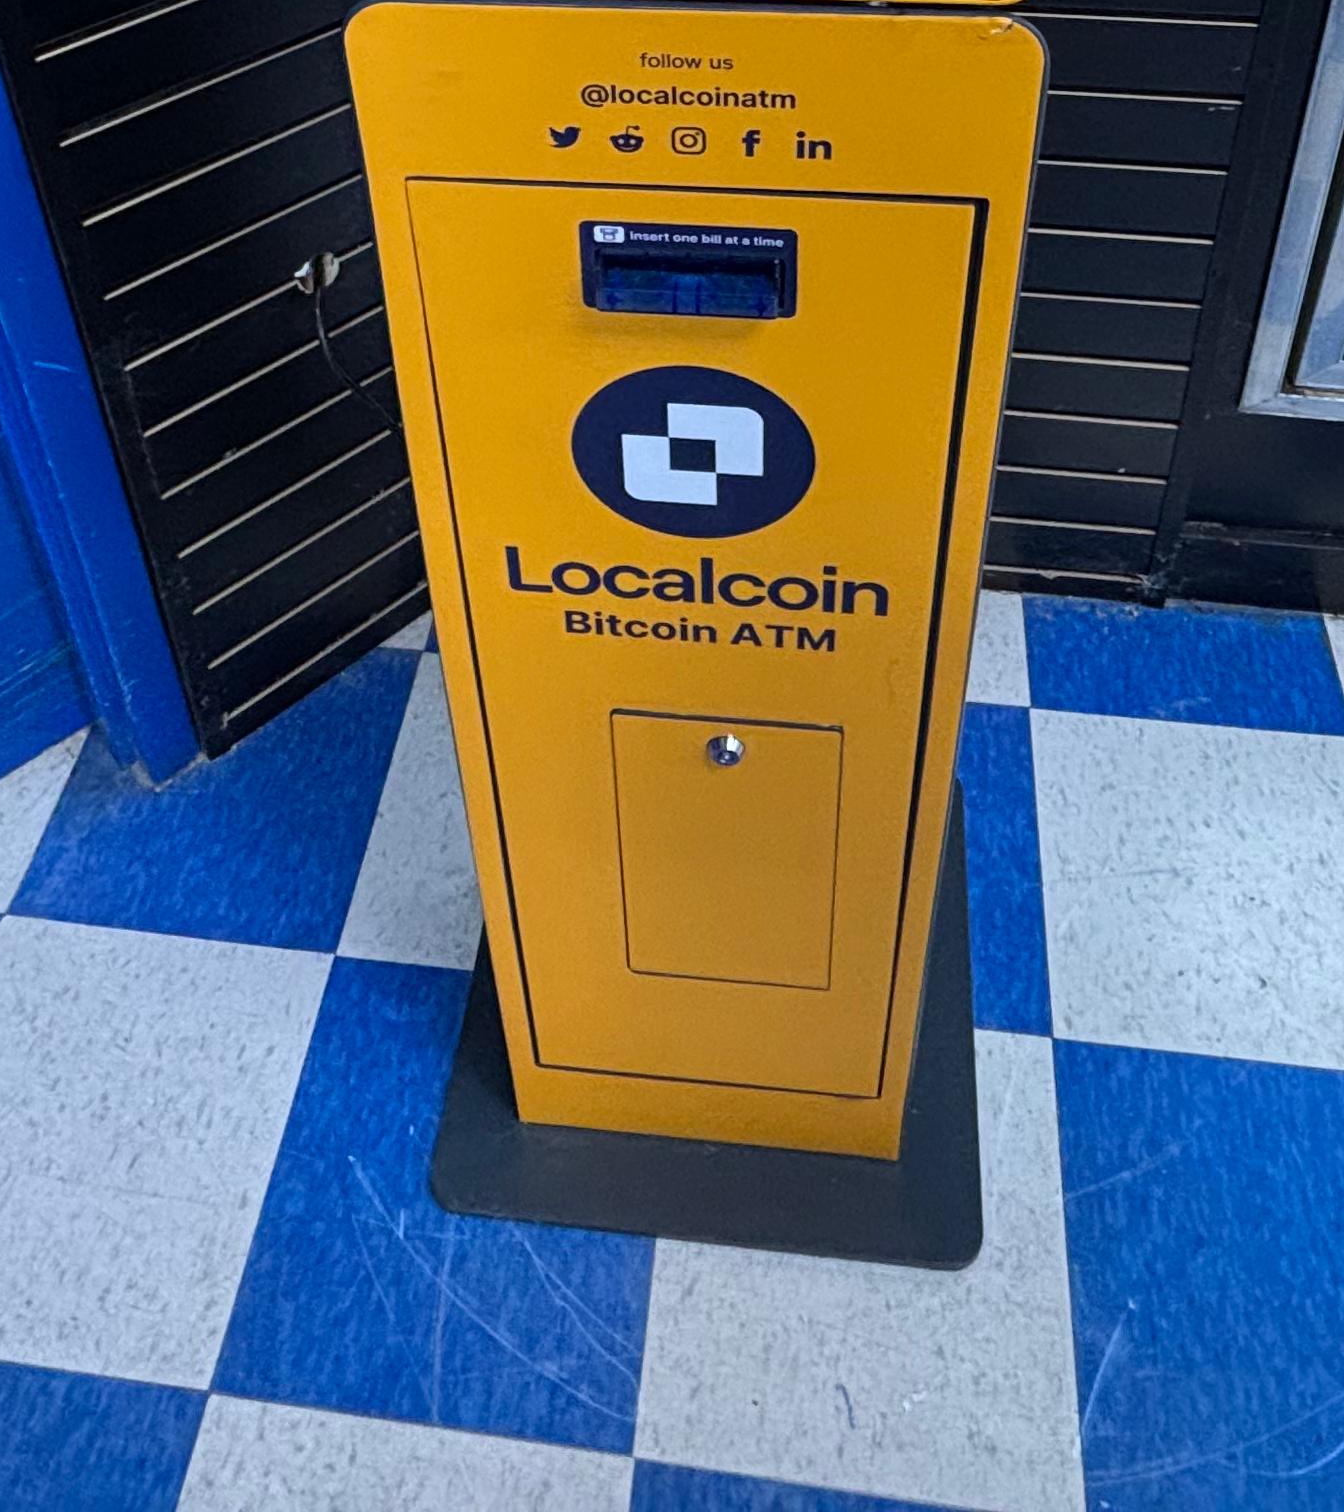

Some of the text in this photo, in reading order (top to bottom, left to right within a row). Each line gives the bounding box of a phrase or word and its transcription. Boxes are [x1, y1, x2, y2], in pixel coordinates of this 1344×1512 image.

[640, 52, 735, 70] follow us
[580, 84, 797, 110] @localcoinatm
[630, 230, 785, 248] Insert one bill at a time
[504, 546, 890, 617] Localcoin
[564, 609, 837, 652] Bitcoin ATM
